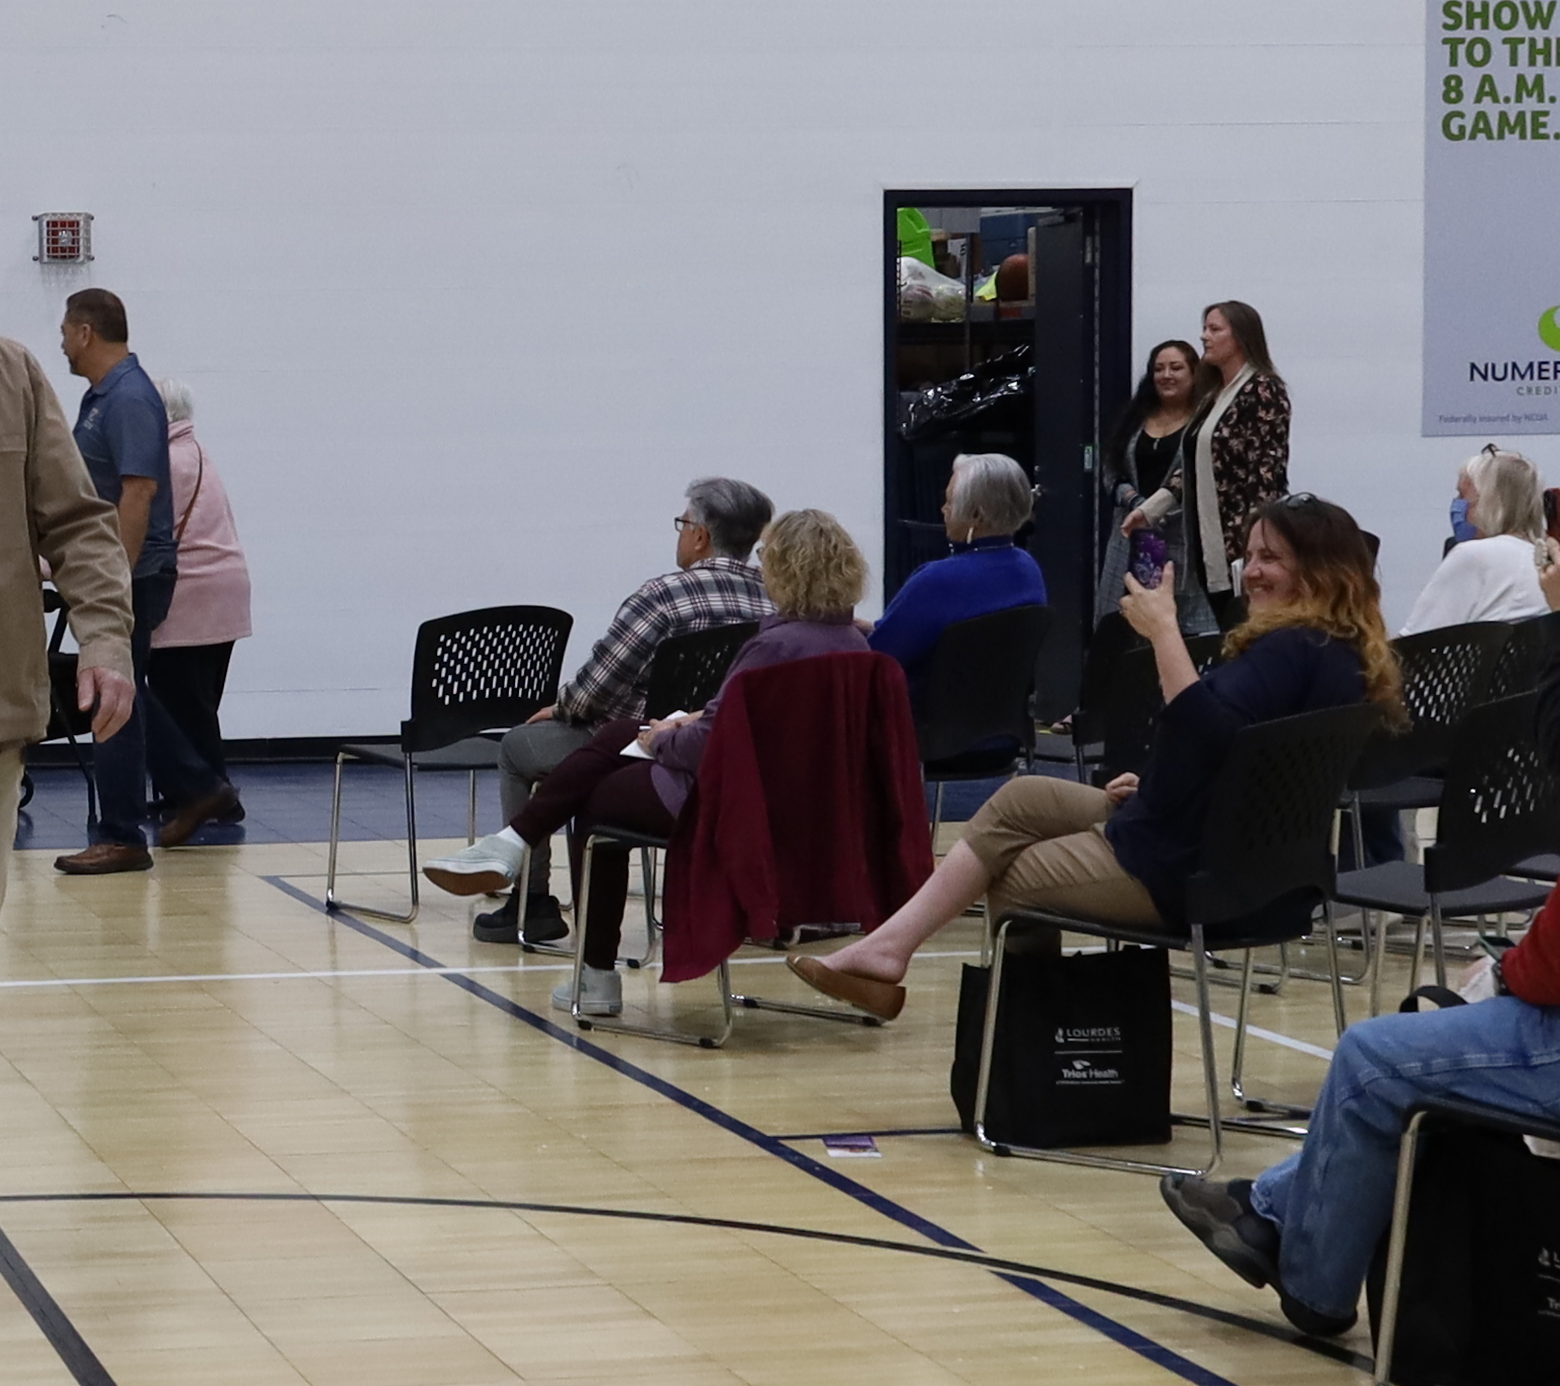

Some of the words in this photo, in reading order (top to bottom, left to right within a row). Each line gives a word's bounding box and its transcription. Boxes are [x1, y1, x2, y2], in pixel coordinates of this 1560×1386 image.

[1441, 0, 1557, 32] SHOW
[1441, 36, 1492, 68] TO
[1441, 73, 1464, 105] 8
[1473, 73, 1558, 105] A.M.
[1066, 1027, 1121, 1037] LOURDES
